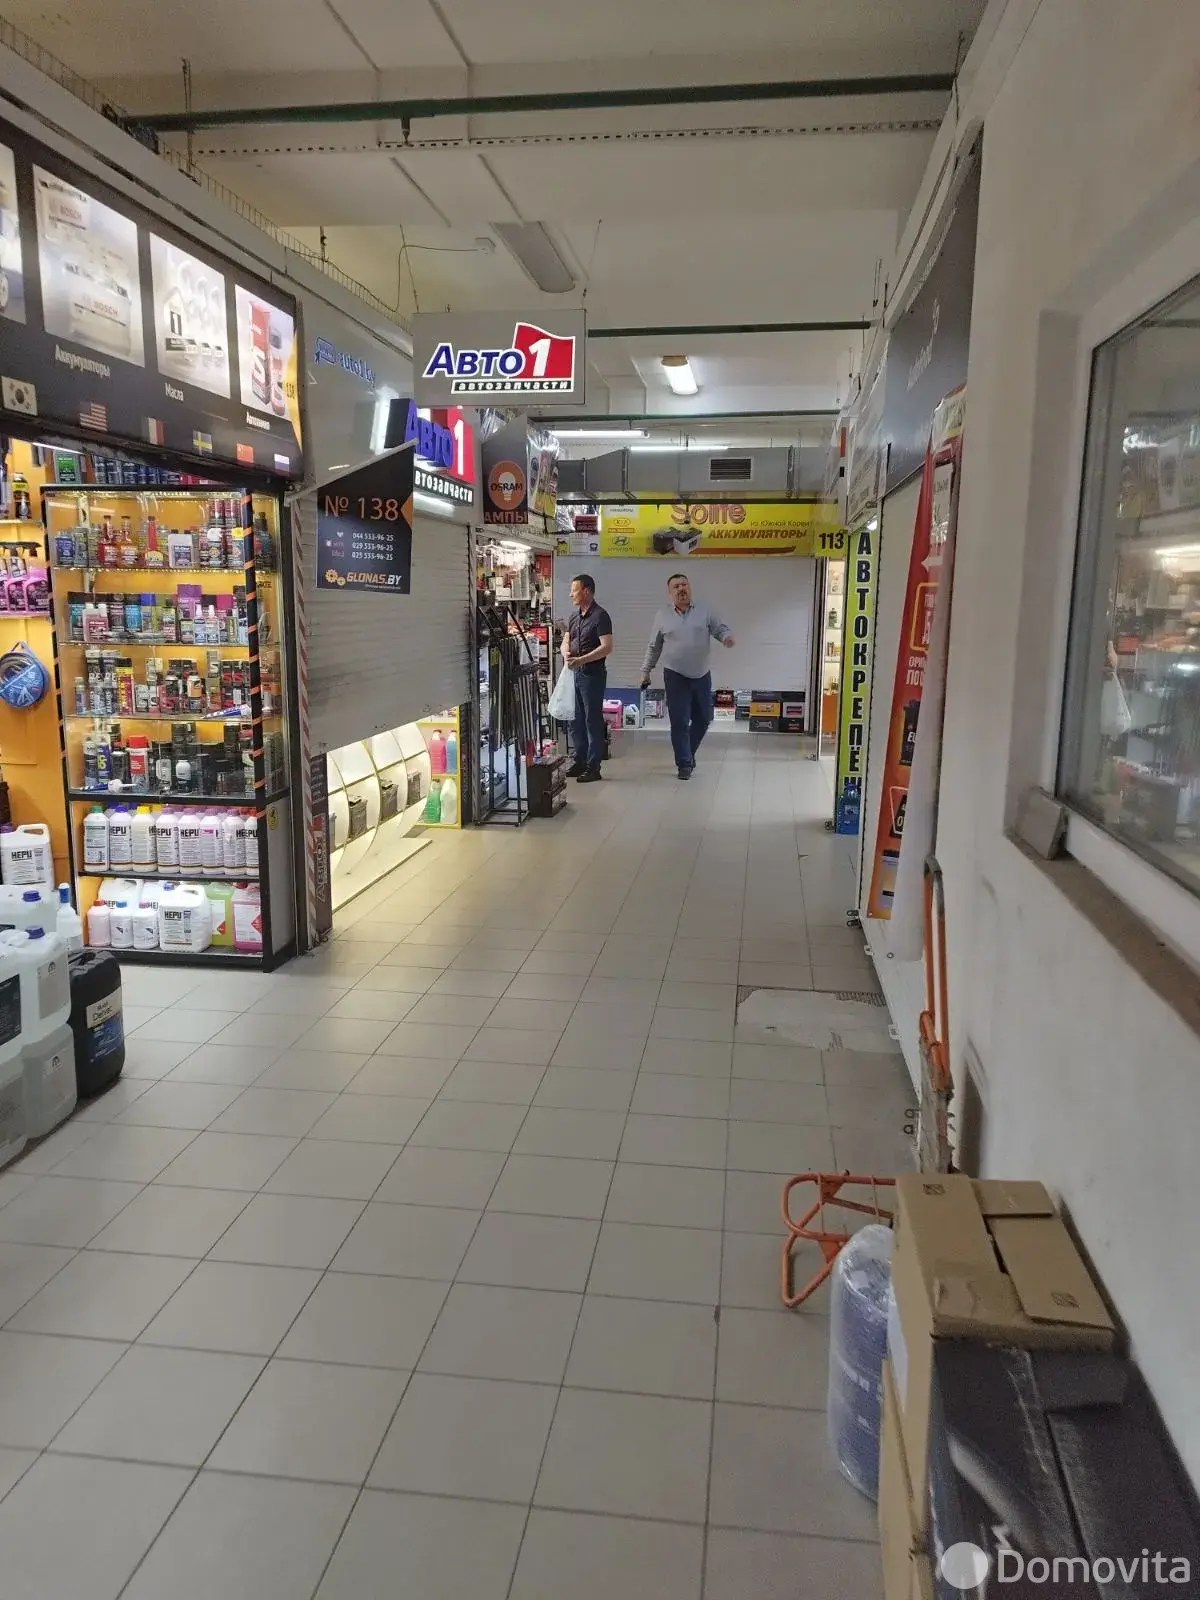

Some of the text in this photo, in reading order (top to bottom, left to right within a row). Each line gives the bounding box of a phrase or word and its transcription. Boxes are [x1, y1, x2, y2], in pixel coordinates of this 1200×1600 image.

[55, 344, 111, 378] Аккумуляторы
[164, 382, 184, 402] Масла
[414, 470, 473, 503] втозапчасти
[490, 482, 523, 491] OSRAM
[325, 495, 399, 520] № 138
[708, 529, 807, 539] АККУМУЛЯТОРЫ
[818, 532, 844, 549] 113
[346, 571, 402, 585] GLONAS.BY
[157, 827, 172, 837] EPU
[180, 828, 199, 838] HEPU
[245, 828, 258, 838] EPU
[11, 850, 32, 860] HEPU
[164, 910, 182, 920] HEPU
